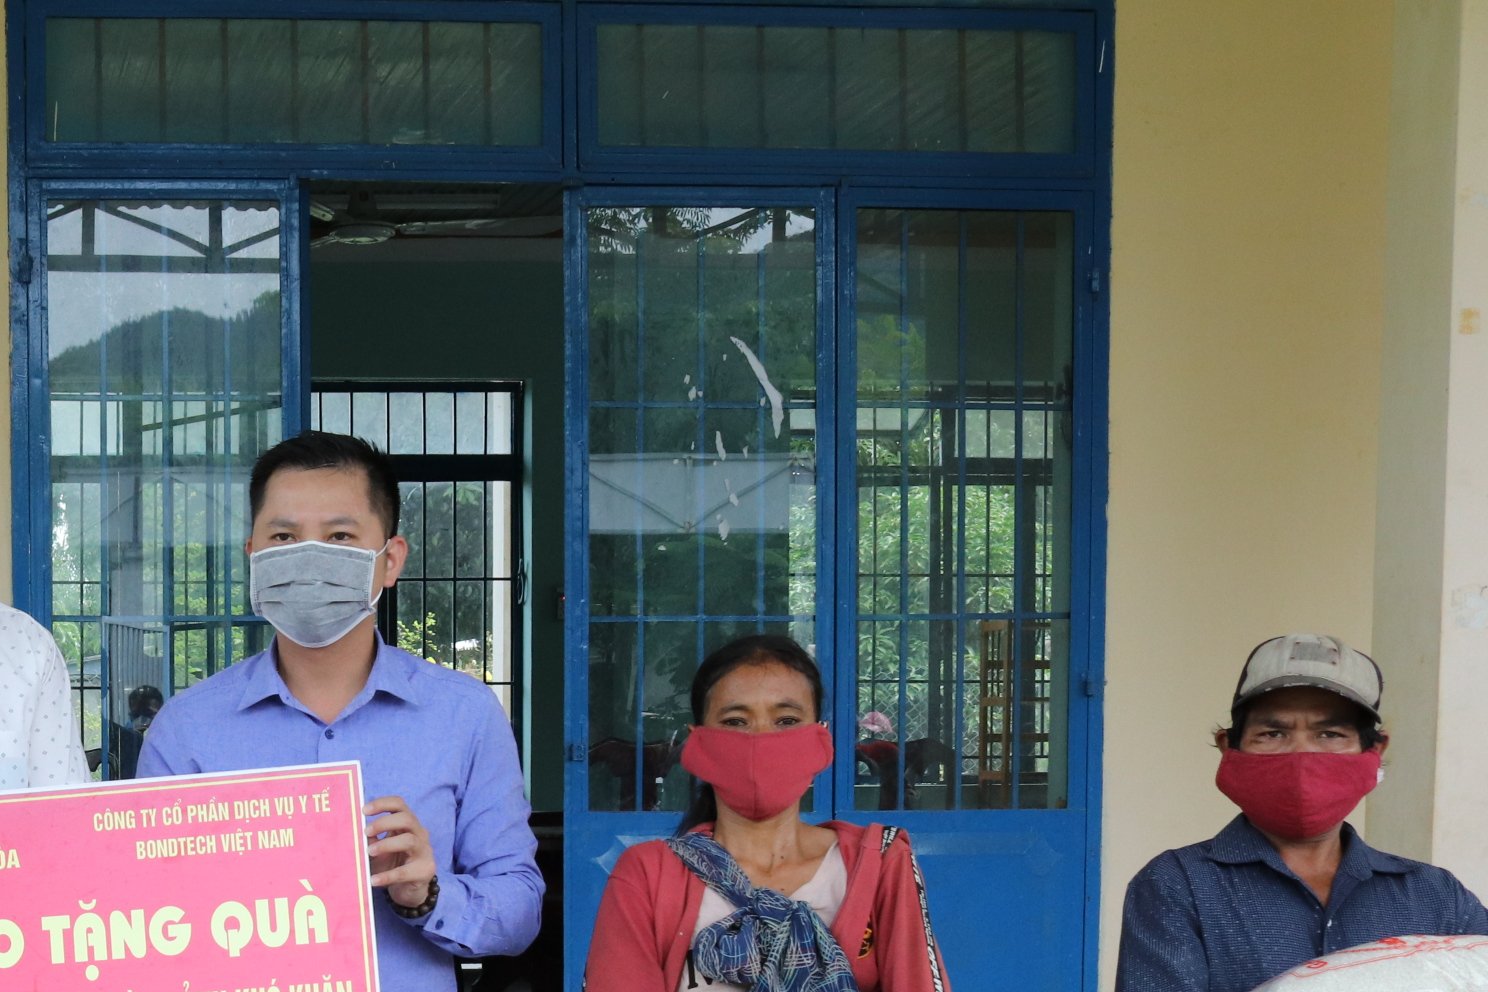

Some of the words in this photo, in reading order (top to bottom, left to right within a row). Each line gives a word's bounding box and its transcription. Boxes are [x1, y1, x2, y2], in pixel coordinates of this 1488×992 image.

[93, 806, 136, 831] CÔNG
[140, 809, 157, 827] TY
[163, 798, 183, 826] CỔ
[187, 798, 230, 823] PHẦN
[234, 799, 270, 823] DỊCH
[274, 797, 295, 818] VỤ
[299, 795, 311, 813] Y
[313, 788, 331, 812] TẾ
[136, 836, 217, 860] BONDTECH
[221, 829, 254, 856] VIỆT
[258, 828, 294, 849] NAM
[42, 898, 192, 981] TẶNG
[211, 879, 329, 957] QUÀ
